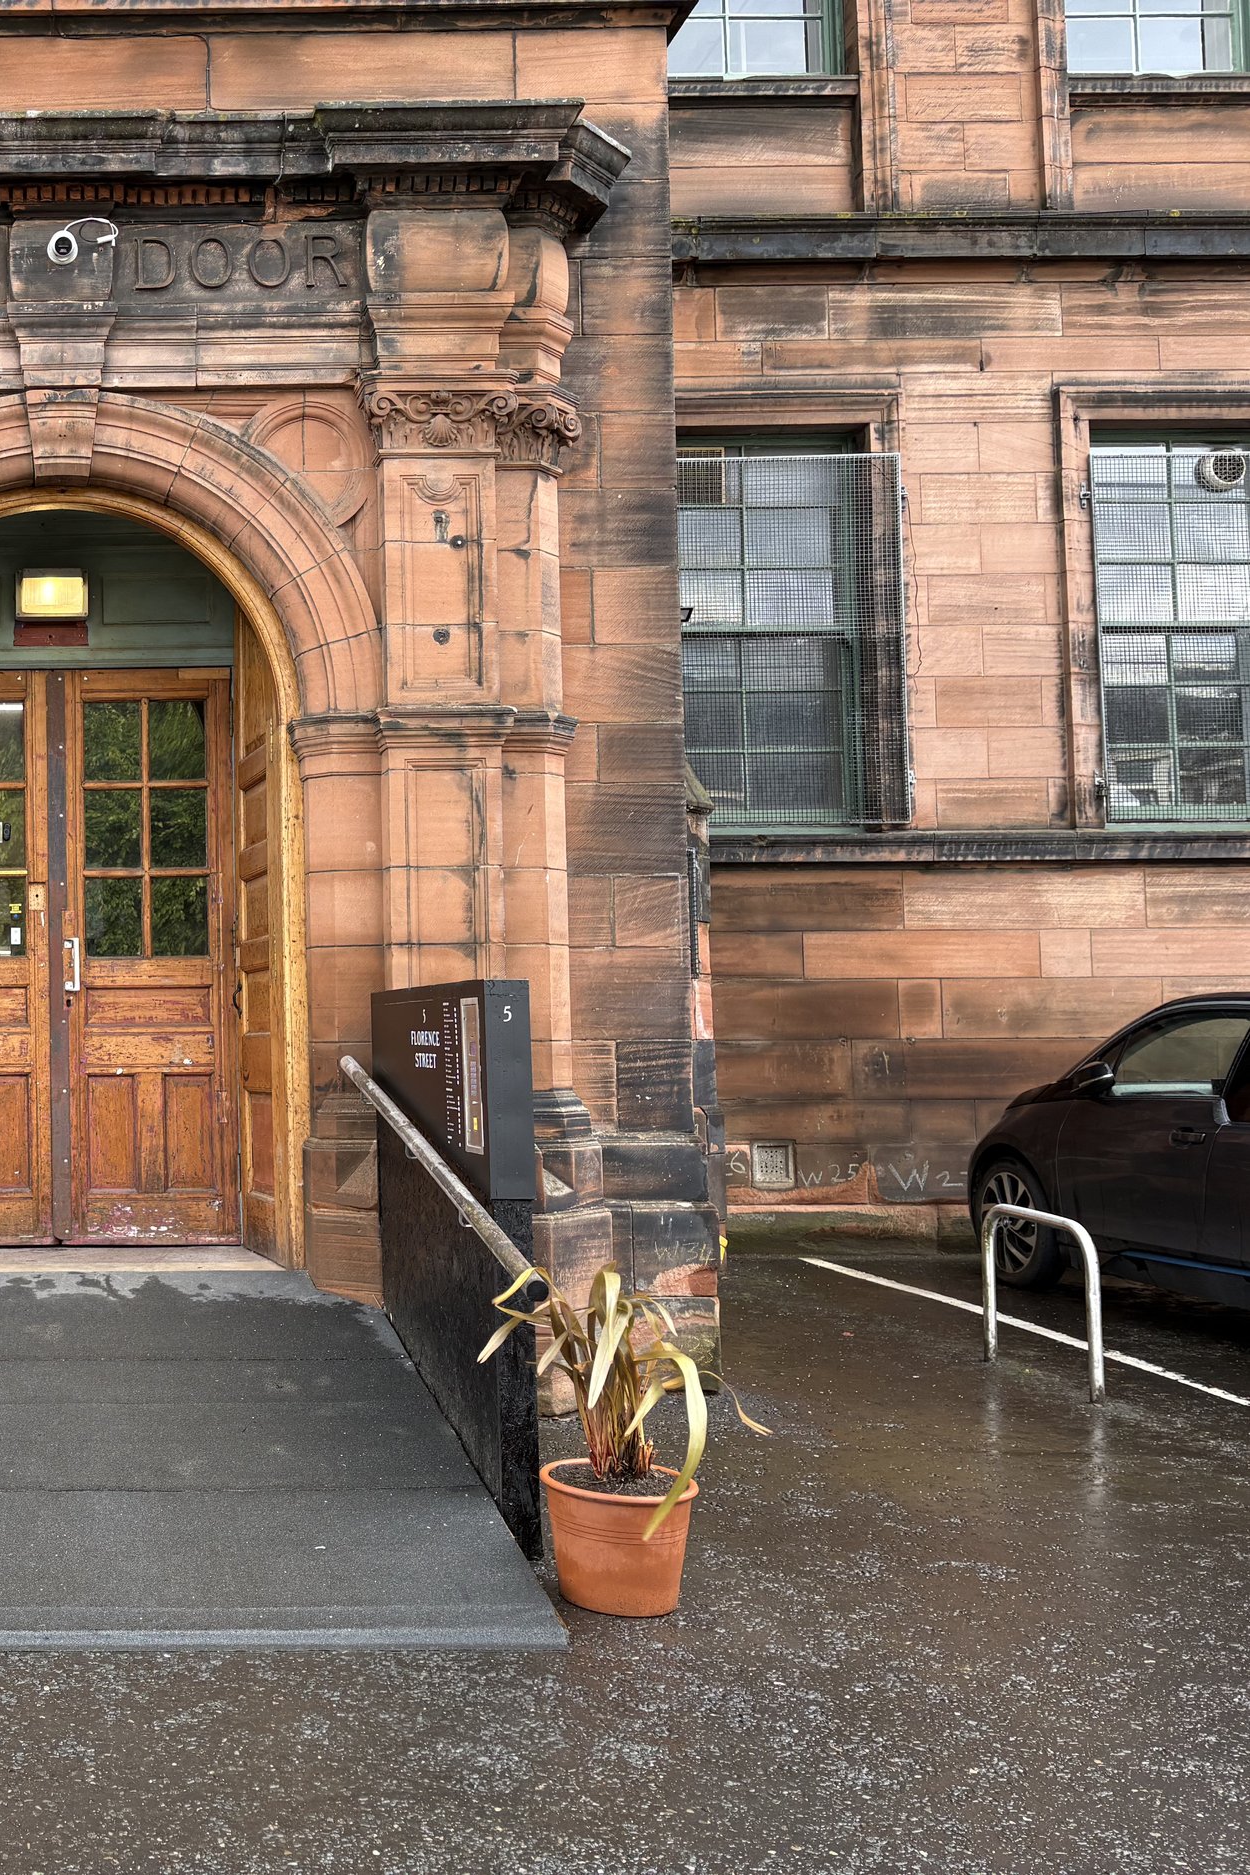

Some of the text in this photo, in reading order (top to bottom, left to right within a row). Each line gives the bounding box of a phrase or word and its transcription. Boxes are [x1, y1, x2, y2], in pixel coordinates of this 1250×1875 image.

[133, 233, 347, 290] DOOR
[422, 1009, 427, 1023] 5
[502, 1005, 512, 1023] 5
[410, 1031, 440, 1047] FLORENCE
[415, 1053, 437, 1069] STREET
